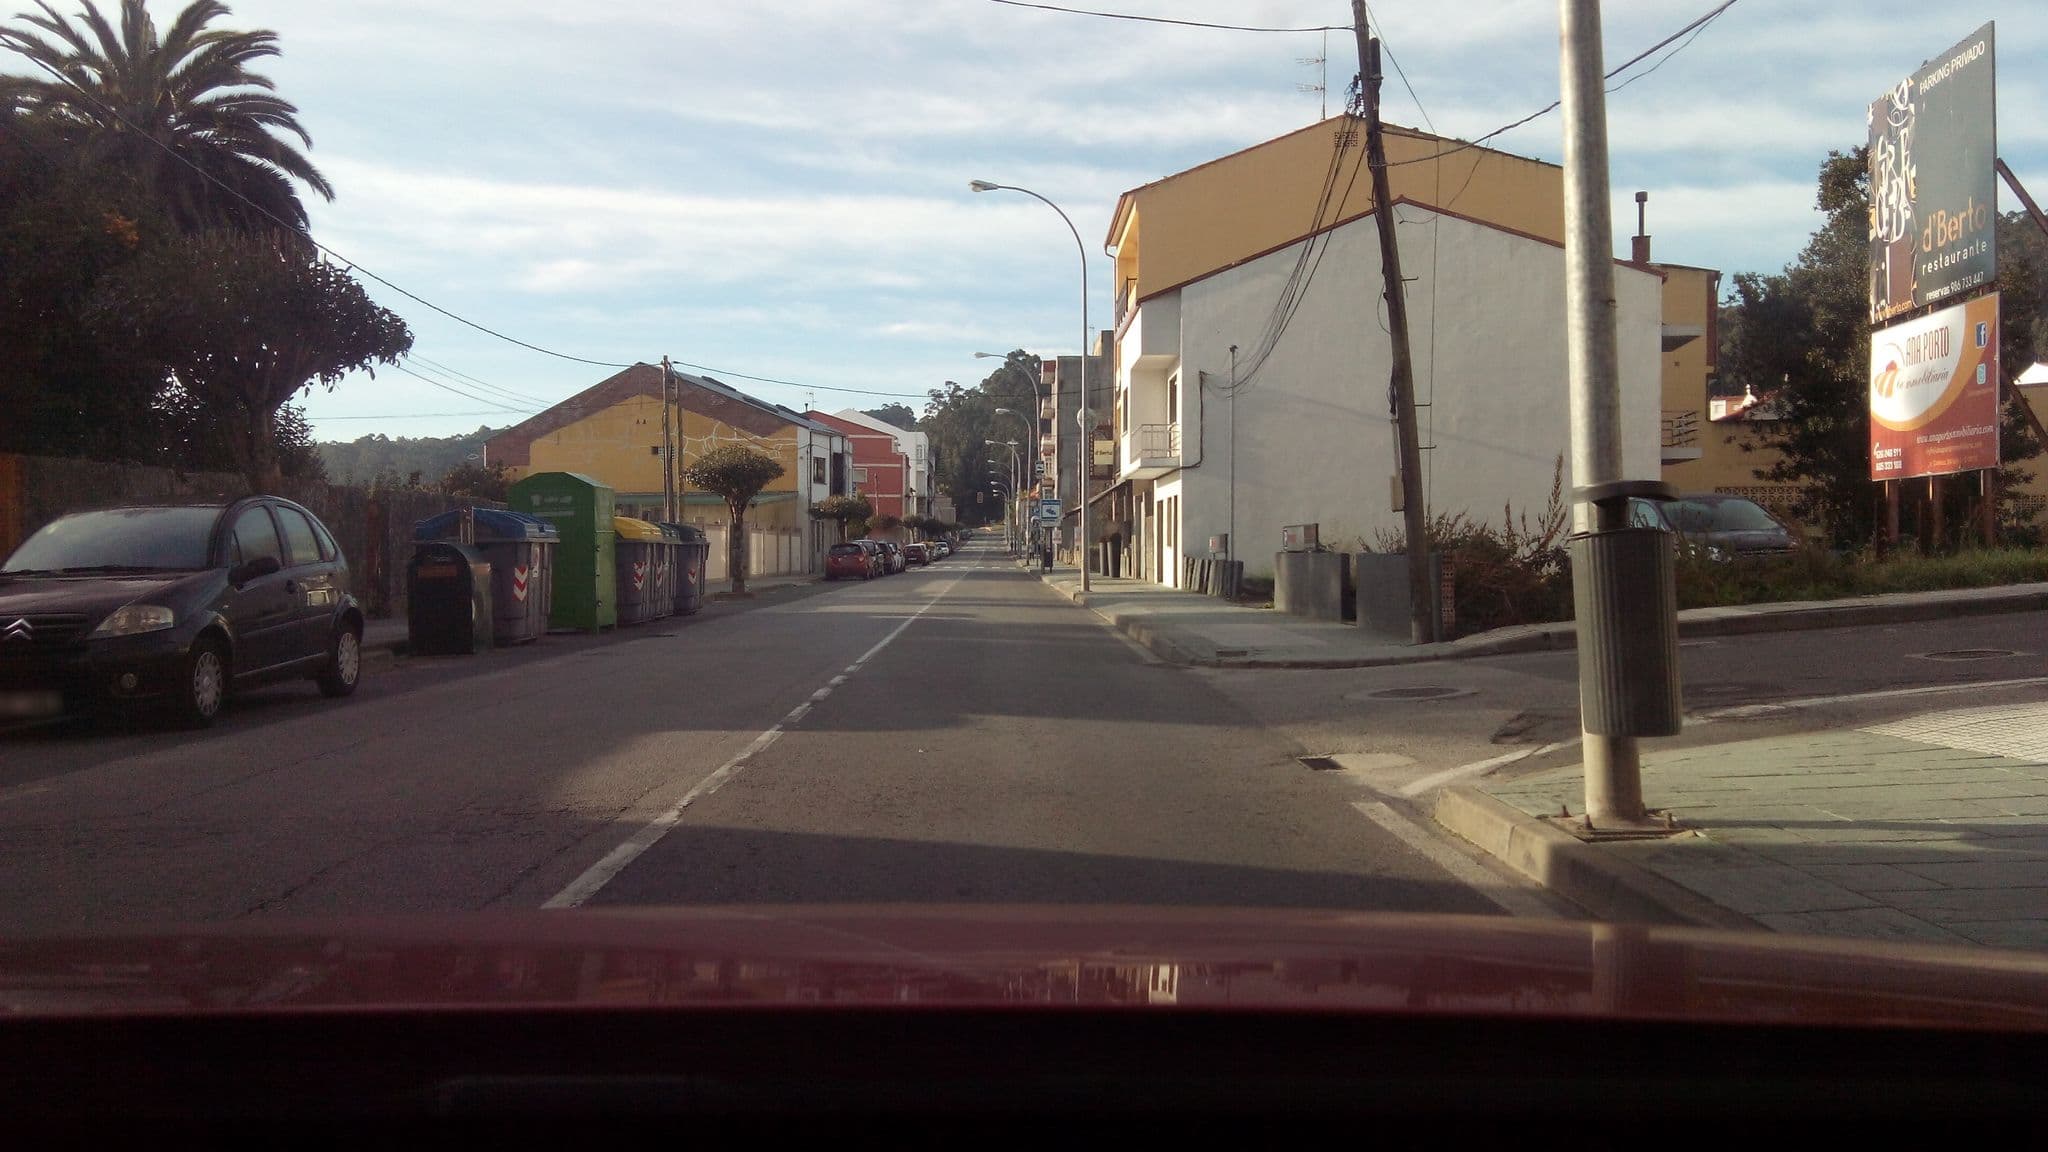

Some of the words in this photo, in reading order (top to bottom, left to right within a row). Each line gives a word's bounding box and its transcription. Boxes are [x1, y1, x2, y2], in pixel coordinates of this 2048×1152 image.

[1919, 63, 1950, 96] PARKING
[1951, 40, 1985, 73] PRIVADO
[1922, 196, 1986, 252] d'Berto
[1922, 239, 1987, 276] restaurante
[1926, 285, 1950, 301] reservas
[1923, 326, 1950, 361] PORTO
